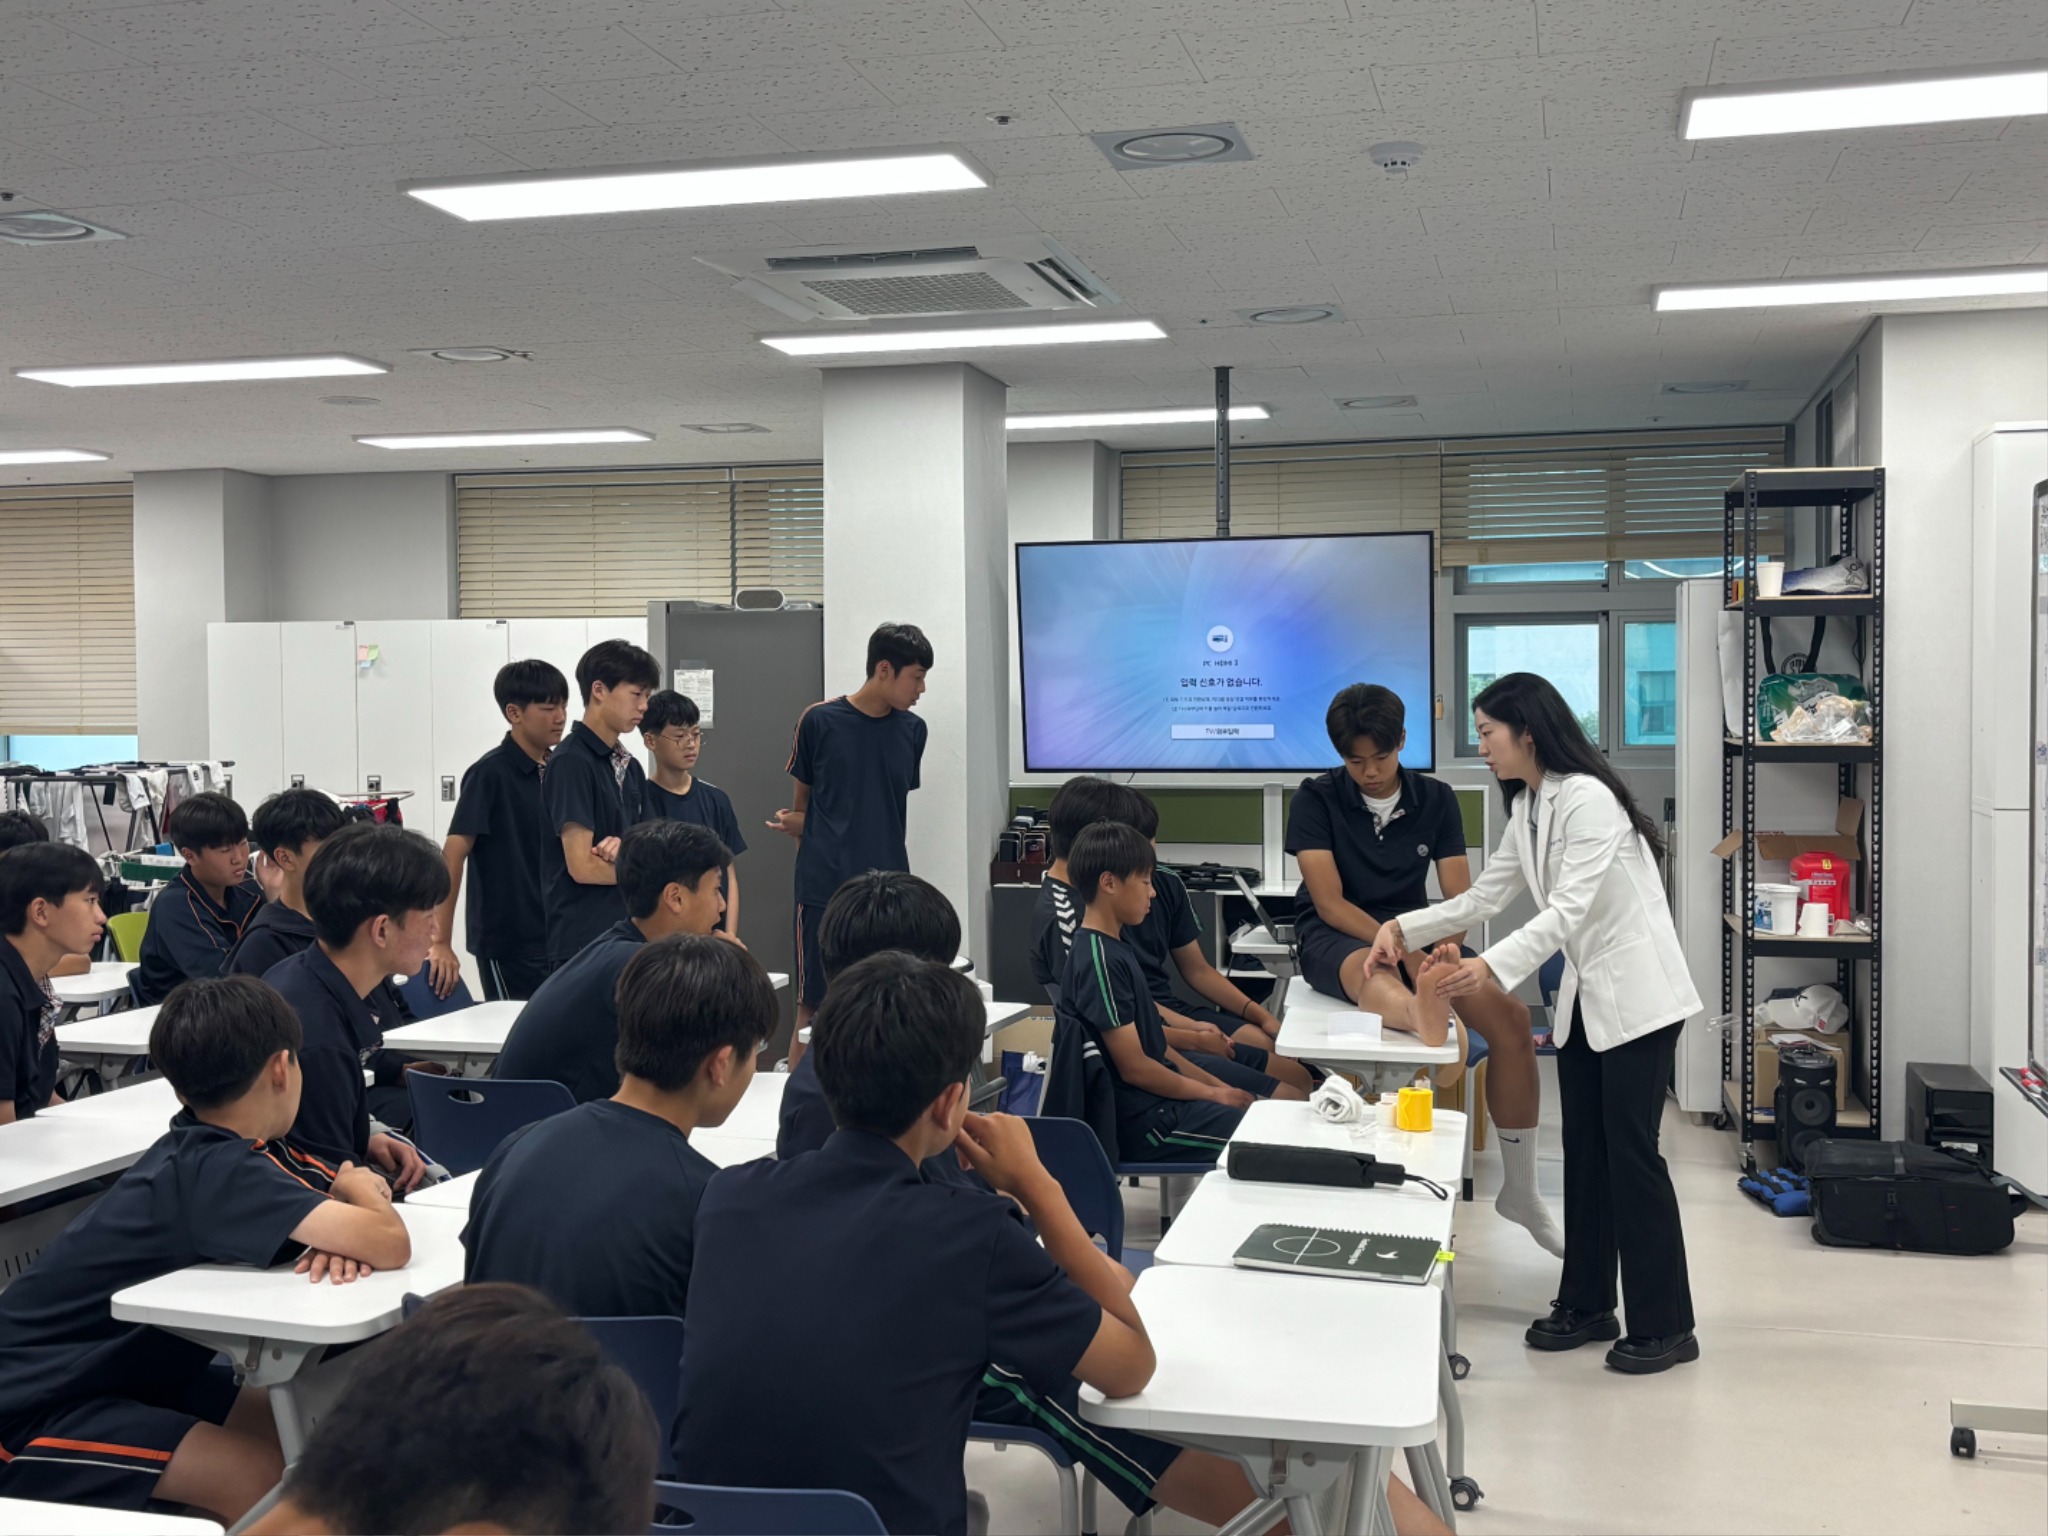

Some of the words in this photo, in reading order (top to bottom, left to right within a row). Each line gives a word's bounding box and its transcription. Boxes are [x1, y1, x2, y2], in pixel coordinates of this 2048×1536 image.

[1181, 677, 1197, 688] 입력
[1200, 677, 1225, 688] 신호가
[1226, 677, 1263, 688] 없습니다.
